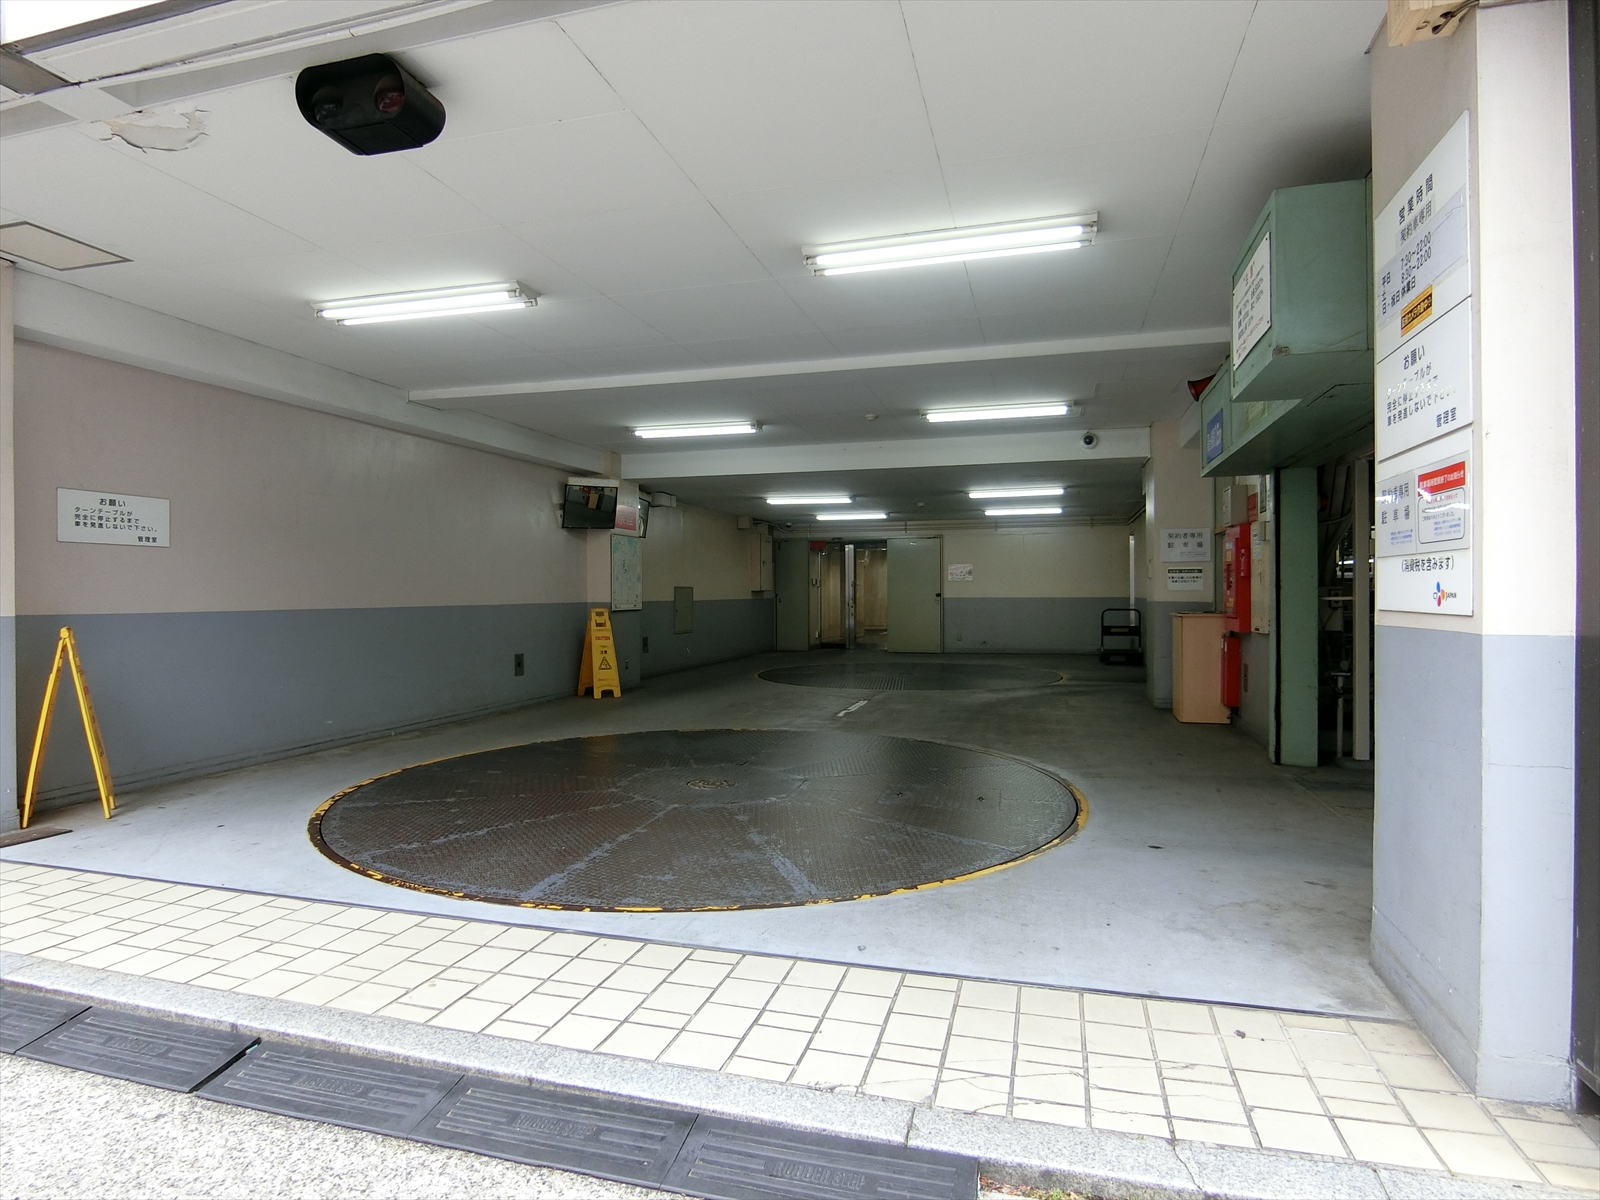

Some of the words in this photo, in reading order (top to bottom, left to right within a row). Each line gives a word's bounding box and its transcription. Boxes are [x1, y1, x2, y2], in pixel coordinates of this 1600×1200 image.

[1398, 173, 1433, 226] 営業時間
[1403, 345, 1426, 370] お願い
[99, 498, 126, 507] お願い
[74, 506, 133, 517] ターンテーブルが
[74, 513, 140, 524] 完全に停止するまで
[1445, 592, 1457, 601] JAPAN
[773, 1161, 831, 1185] RUBBER
[831, 1171, 866, 1191] STEP
